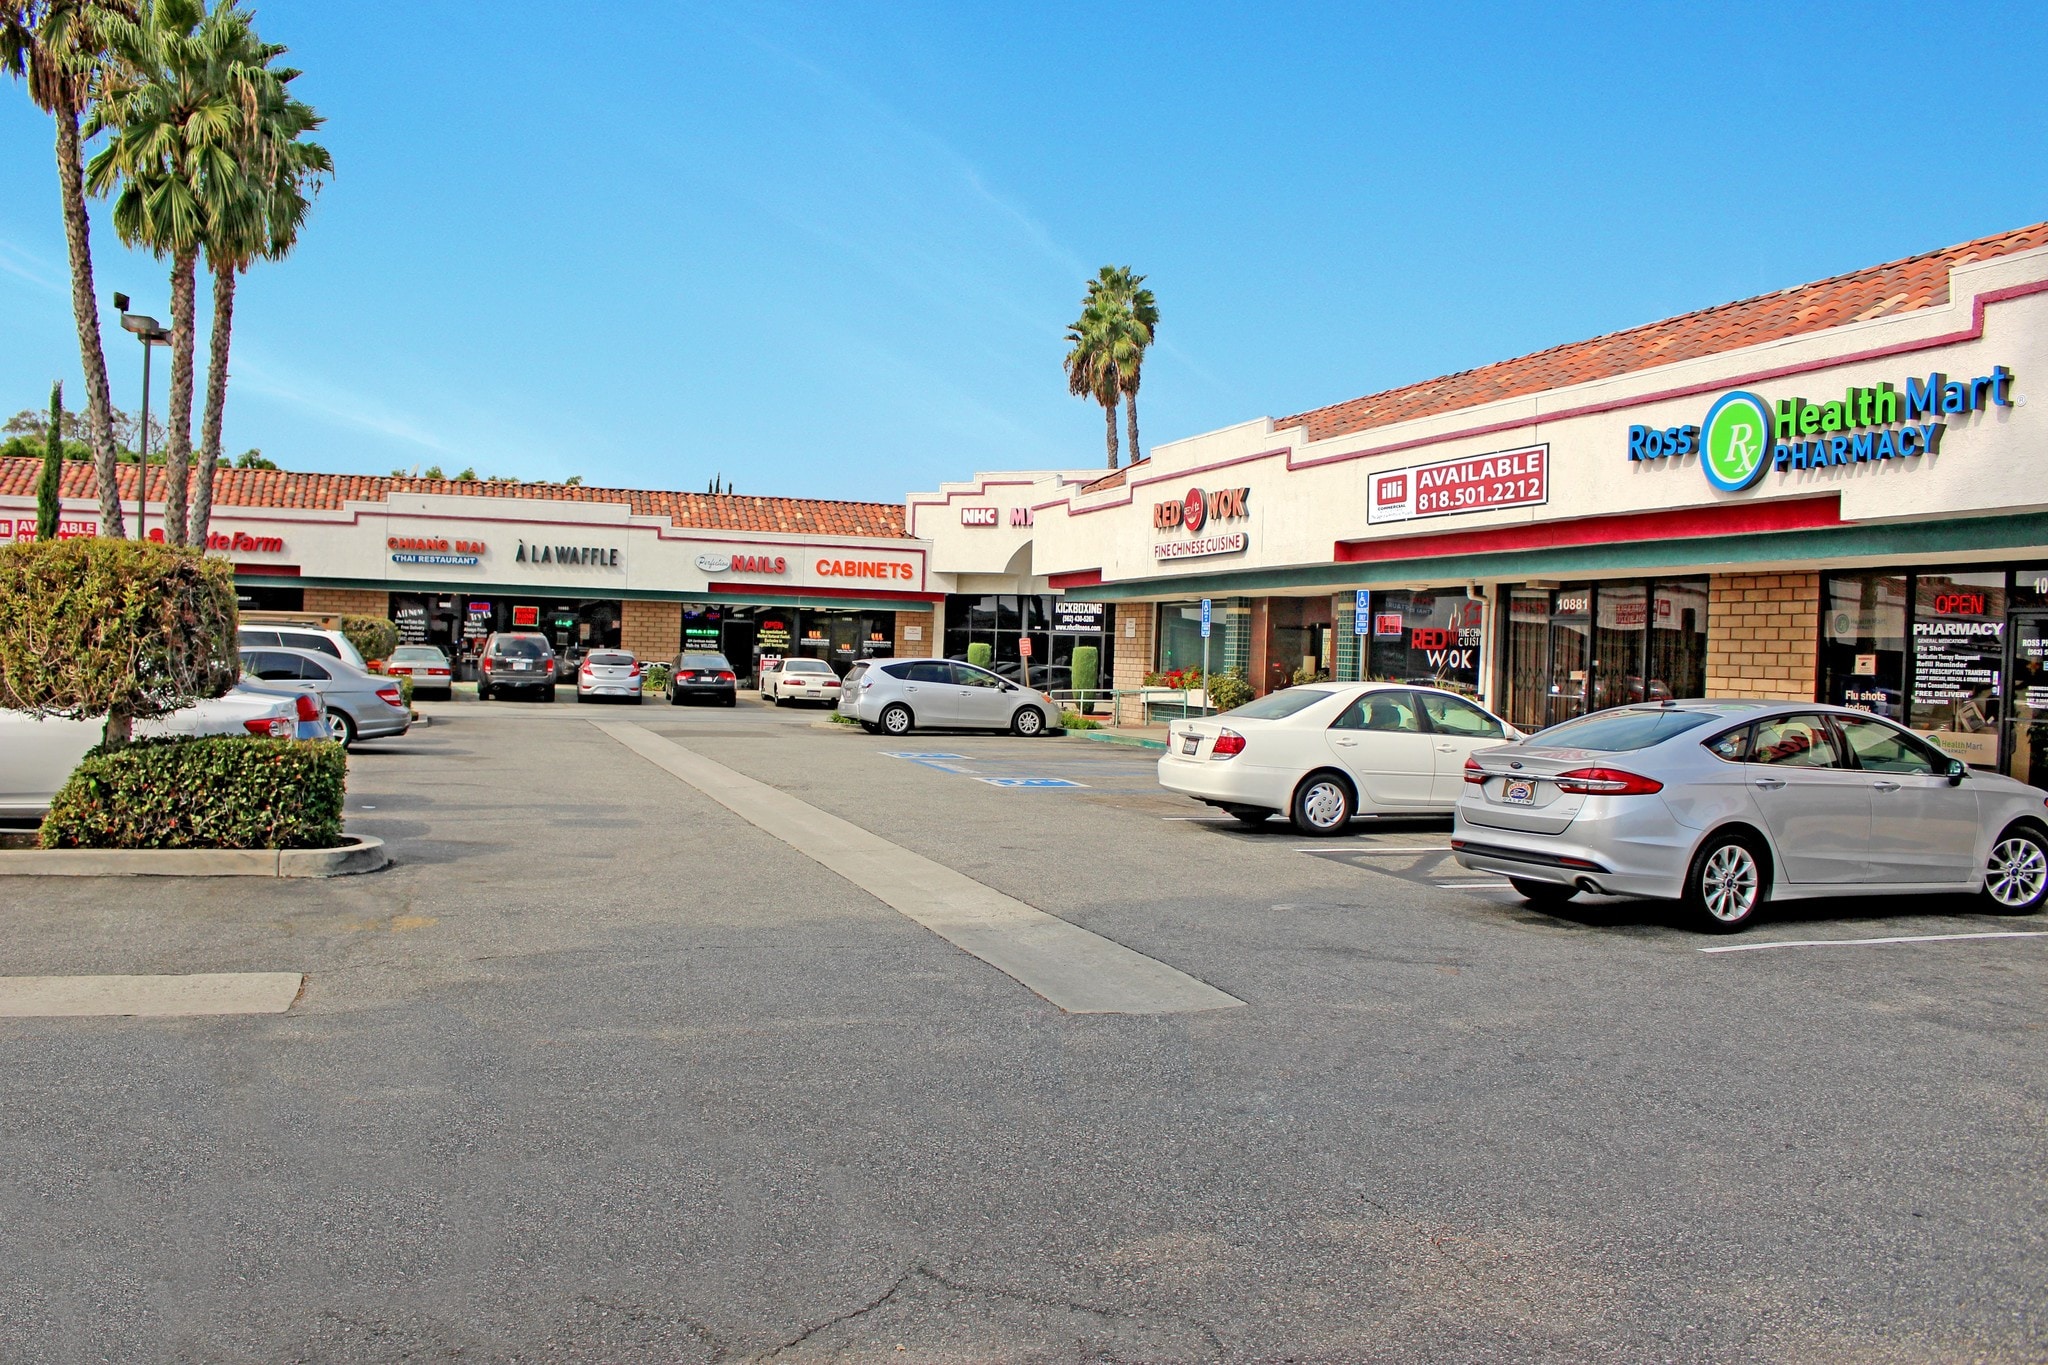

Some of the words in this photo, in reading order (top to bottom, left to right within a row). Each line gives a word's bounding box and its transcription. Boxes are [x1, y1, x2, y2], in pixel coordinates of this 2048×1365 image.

[1628, 424, 1693, 461] Ross
[1774, 423, 1938, 472] PHARMACY
[1419, 453, 1540, 489] AVAILABLE
[1382, 481, 1403, 500] illi
[1418, 478, 1540, 511] 818.501.2212
[962, 508, 996, 524] NHC
[1154, 500, 1182, 528] RED
[1207, 487, 1248, 520] WOK
[19, 520, 96, 534] AVABLE
[231, 531, 283, 552] Farm
[387, 537, 449, 552] CHIANG
[455, 540, 485, 554] MAI
[1155, 544, 1171, 558] FINE
[1172, 540, 1205, 556] CHINESE
[1206, 534, 1240, 552] CUISINE
[418, 556, 476, 564] RESTAURANT
[555, 546, 618, 566] WAFFLE
[731, 555, 786, 574] NAILS
[816, 559, 914, 580] CABINETS
[1056, 602, 1103, 614] KICKBOXING
[1557, 598, 1588, 610] 10881
[1934, 595, 1984, 614] OPEN
[1913, 623, 2004, 635] PHARMACY
[1411, 628, 1448, 650] RED
[2022, 639, 2040, 647] ROSS
[1426, 649, 1473, 668] WOK
[1845, 690, 1859, 700] Flu
[1860, 691, 1887, 701] shots
